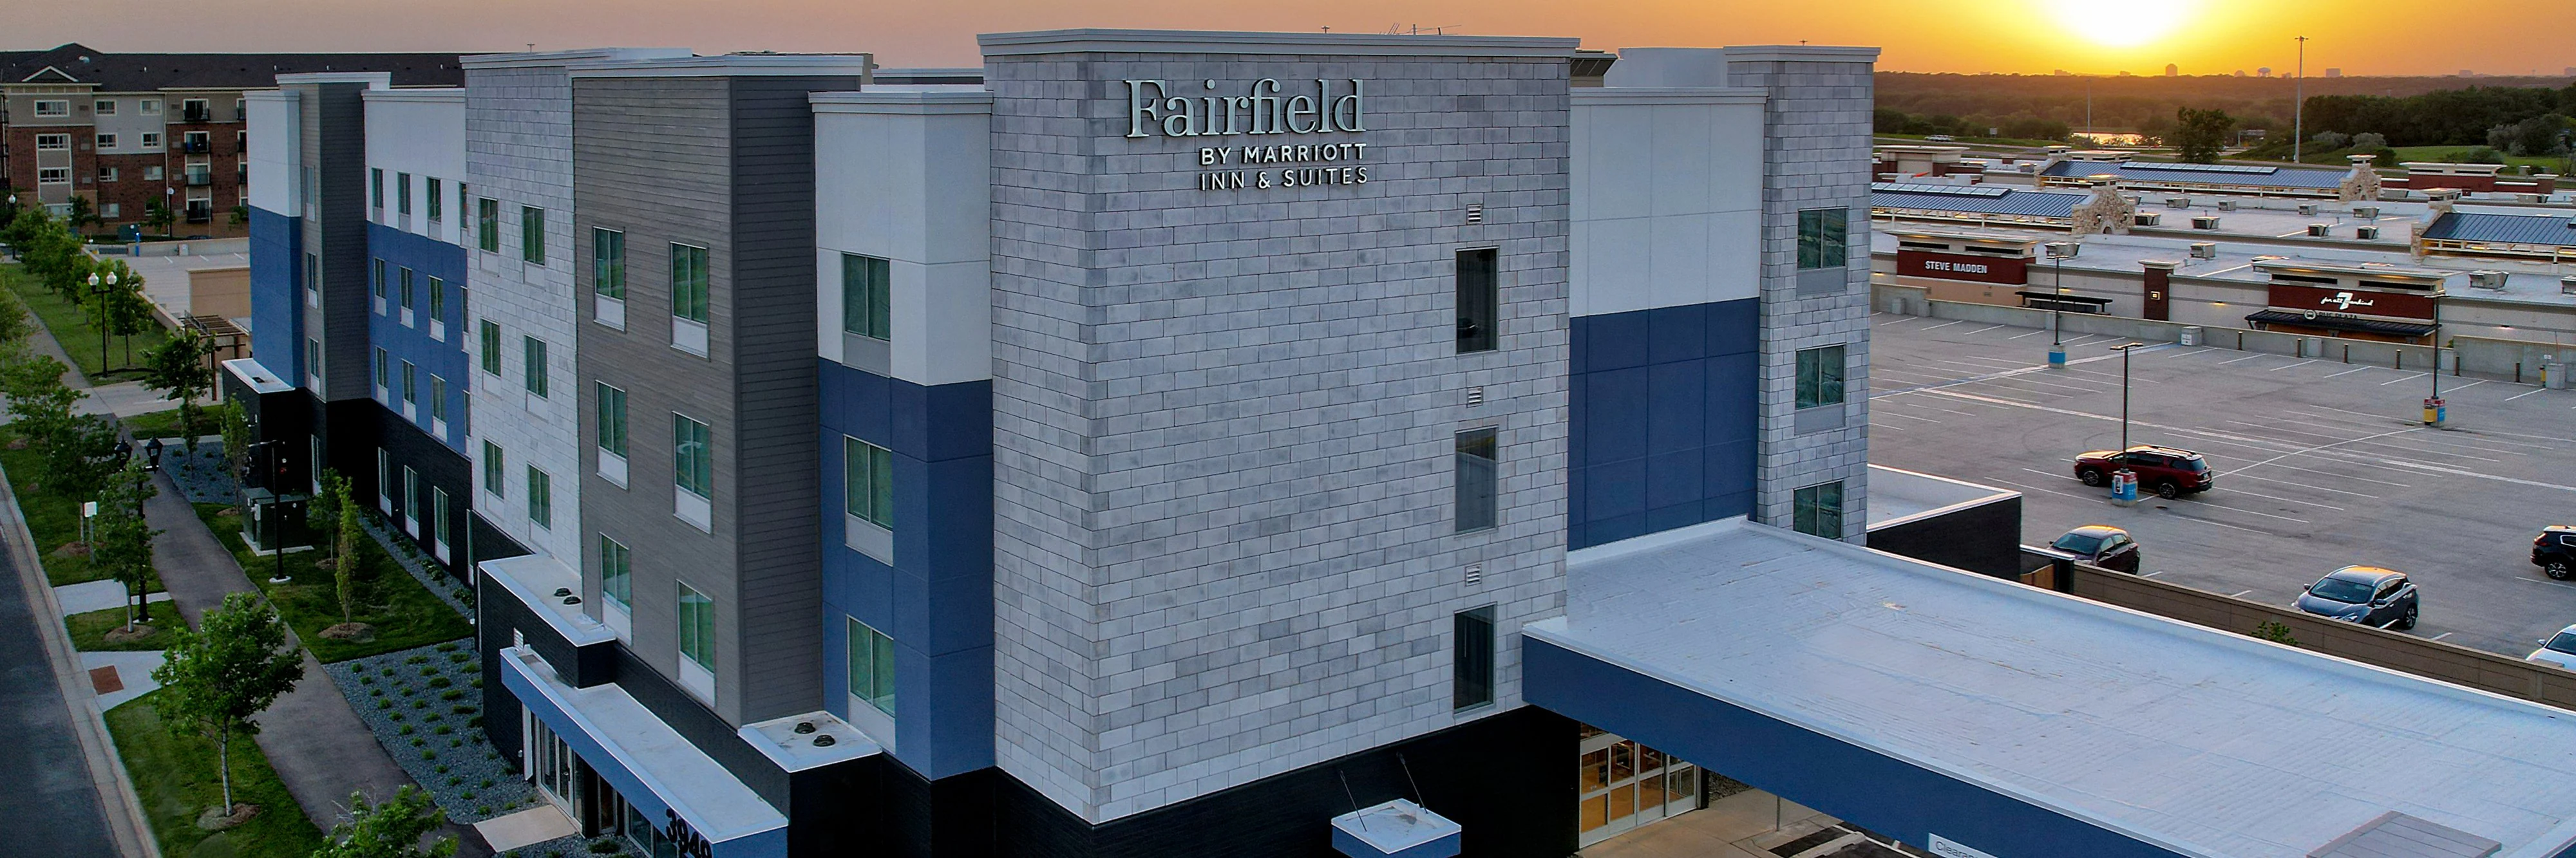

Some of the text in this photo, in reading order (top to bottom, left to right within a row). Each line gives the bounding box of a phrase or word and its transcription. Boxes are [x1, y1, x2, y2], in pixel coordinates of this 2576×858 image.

[1123, 79, 1367, 138] Fairfield
[1200, 143, 1367, 165] BY MARRIOTT
[1199, 167, 1368, 191] INN & SUITES
[1926, 261, 1987, 274] STEVE MADDEN
[2336, 292, 2353, 310] 7
[1936, 841, 1978, 858] Cleara
